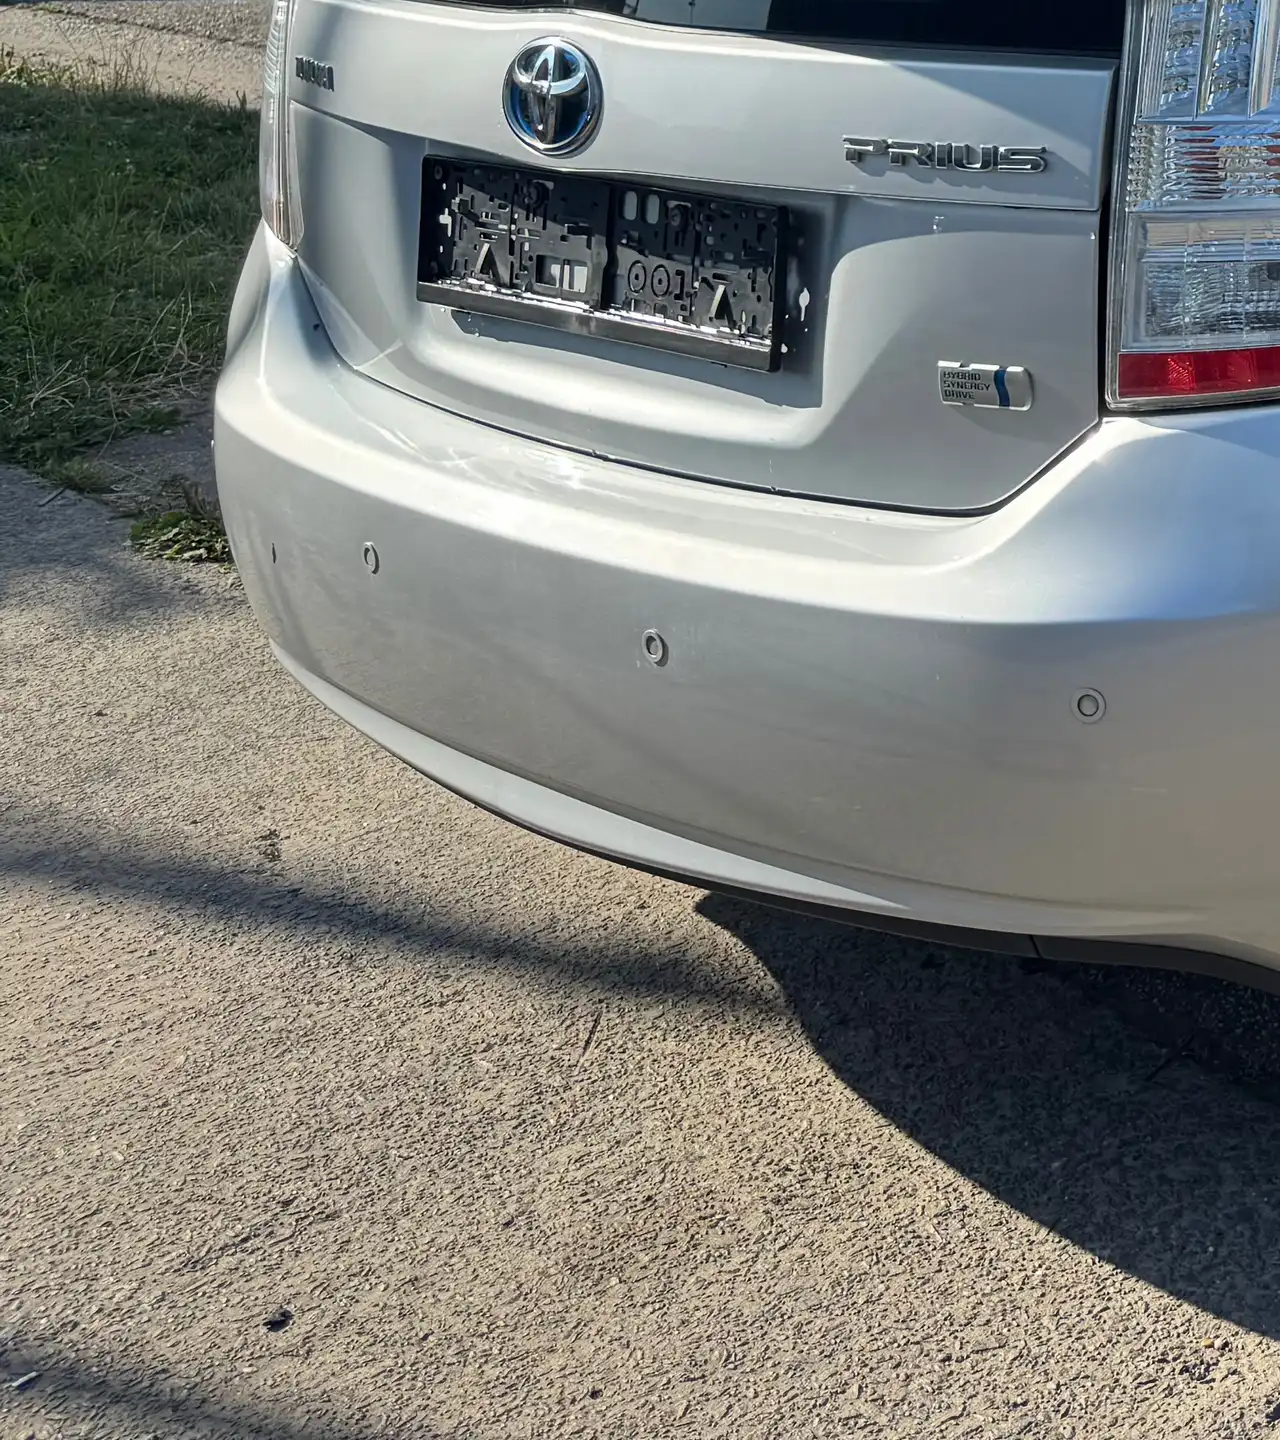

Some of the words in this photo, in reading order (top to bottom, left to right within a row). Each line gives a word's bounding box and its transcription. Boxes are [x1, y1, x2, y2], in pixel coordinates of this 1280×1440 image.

[842, 135, 1047, 173] PRIUS
[943, 370, 981, 381] HYBRID
[943, 380, 991, 391] SYNERGY
[944, 390, 976, 400] DRIVE
